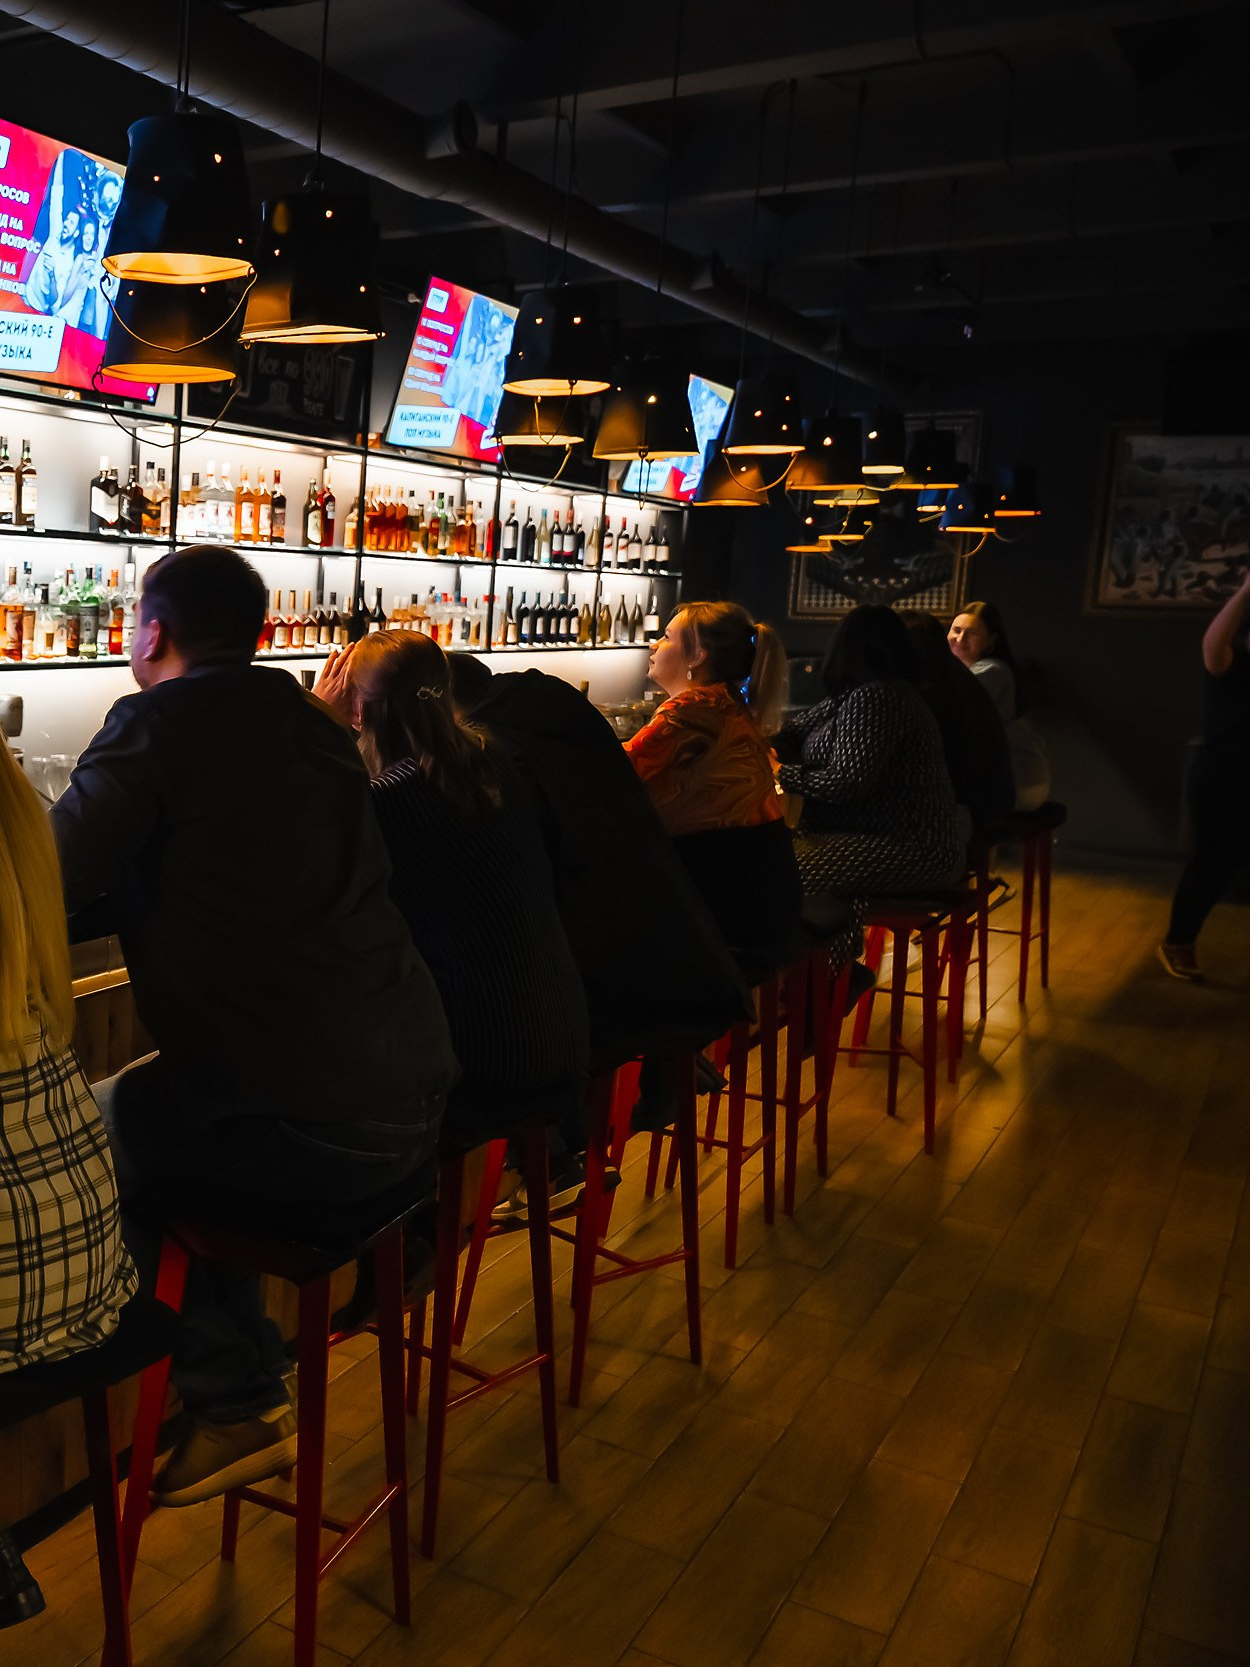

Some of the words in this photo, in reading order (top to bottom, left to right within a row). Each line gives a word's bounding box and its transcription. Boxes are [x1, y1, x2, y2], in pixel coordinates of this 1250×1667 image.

[9, 216, 24, 231] НА
[0, 232, 42, 254] ВОПРОС
[2, 261, 17, 275] НА
[31, 324, 54, 339] 90-Е
